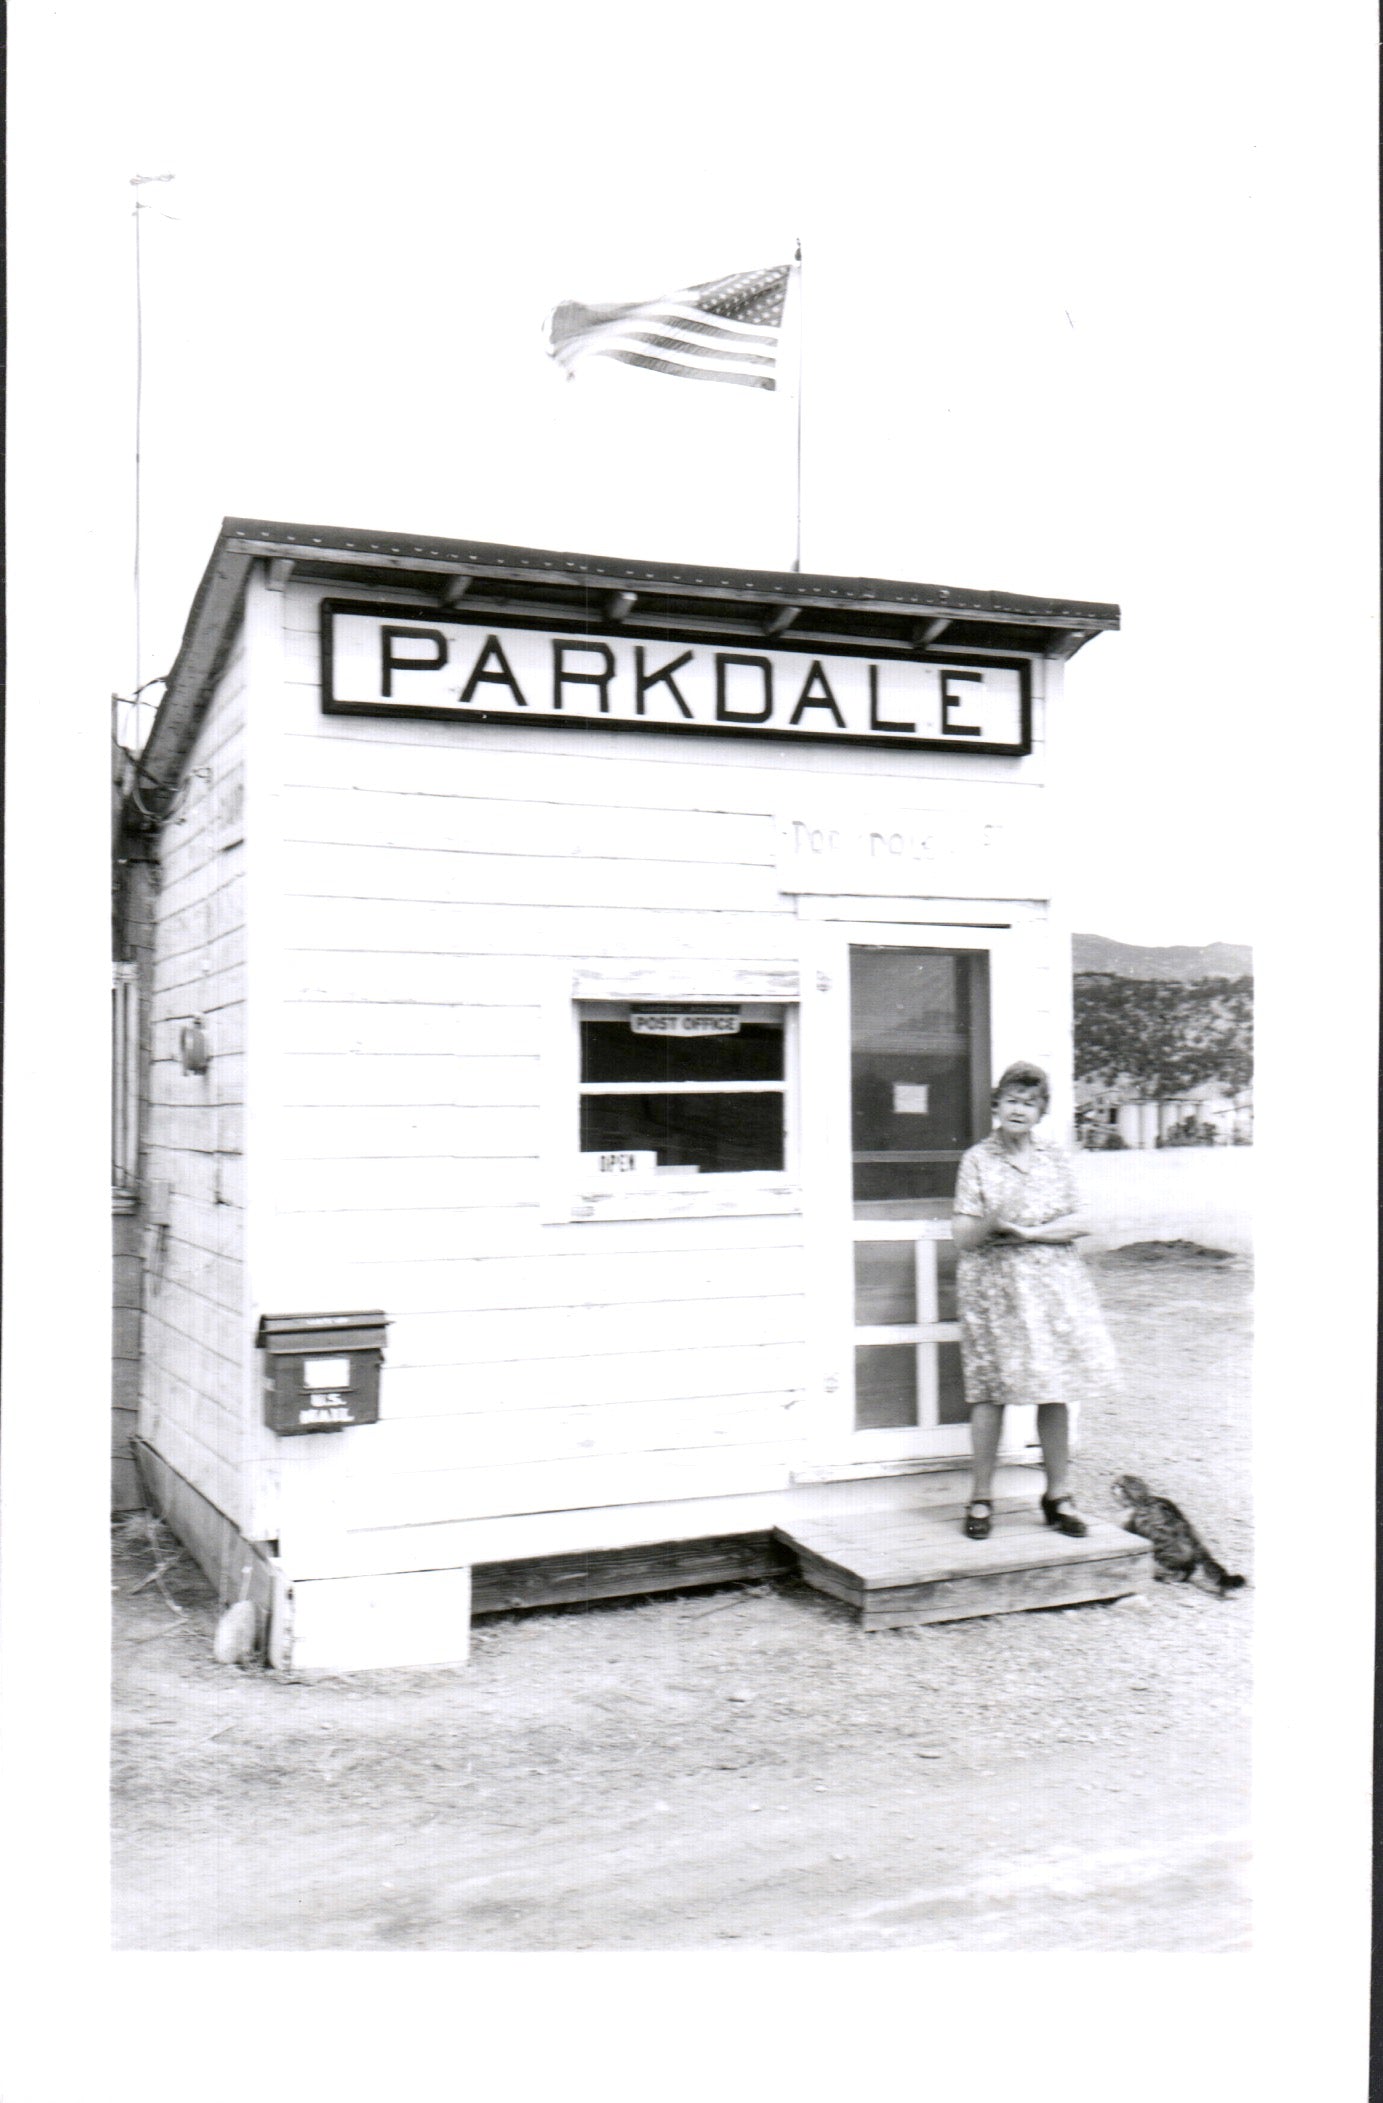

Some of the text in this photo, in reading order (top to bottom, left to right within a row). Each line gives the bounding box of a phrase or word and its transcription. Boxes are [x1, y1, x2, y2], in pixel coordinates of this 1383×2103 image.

[381, 624, 983, 737] PARKDALE
[636, 1016, 735, 1031] POST OFFICE
[599, 1153, 635, 1173] OPEN
[299, 1407, 355, 1424] MAIL
